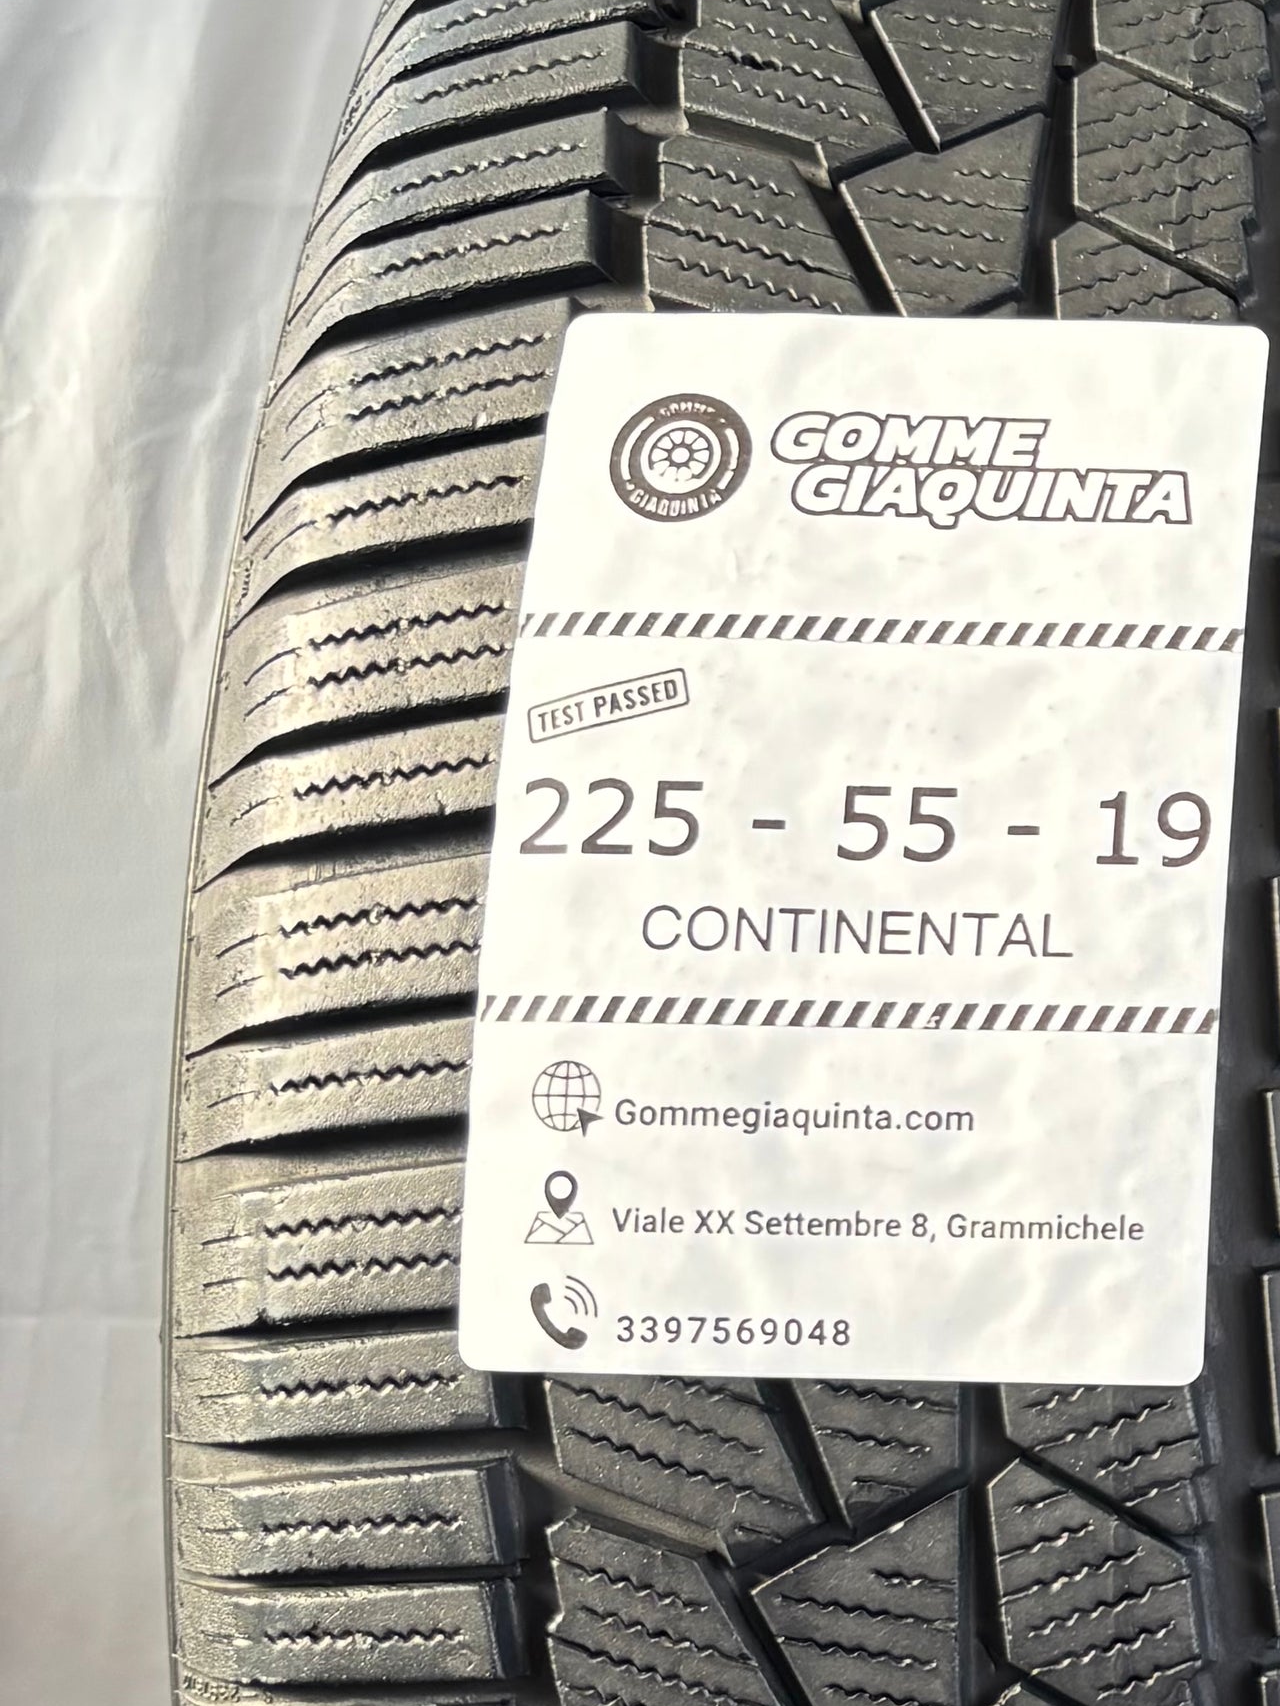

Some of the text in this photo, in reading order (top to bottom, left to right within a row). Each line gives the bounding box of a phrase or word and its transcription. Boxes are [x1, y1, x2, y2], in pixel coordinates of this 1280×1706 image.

[770, 410, 1051, 468] GOMME
[790, 460, 1192, 531] GIAQUINTA
[537, 679, 678, 732] TEST PASSED
[519, 777, 703, 857] 225
[837, 785, 958, 863] 55
[1096, 790, 1211, 868] 19
[642, 904, 1073, 958] CONTINENTAL
[615, 1098, 974, 1136] Gommegiaquinta.com
[612, 1207, 1144, 1243] Viale XX Settembre 8, Grammichele
[617, 1315, 850, 1346] 3397569048
